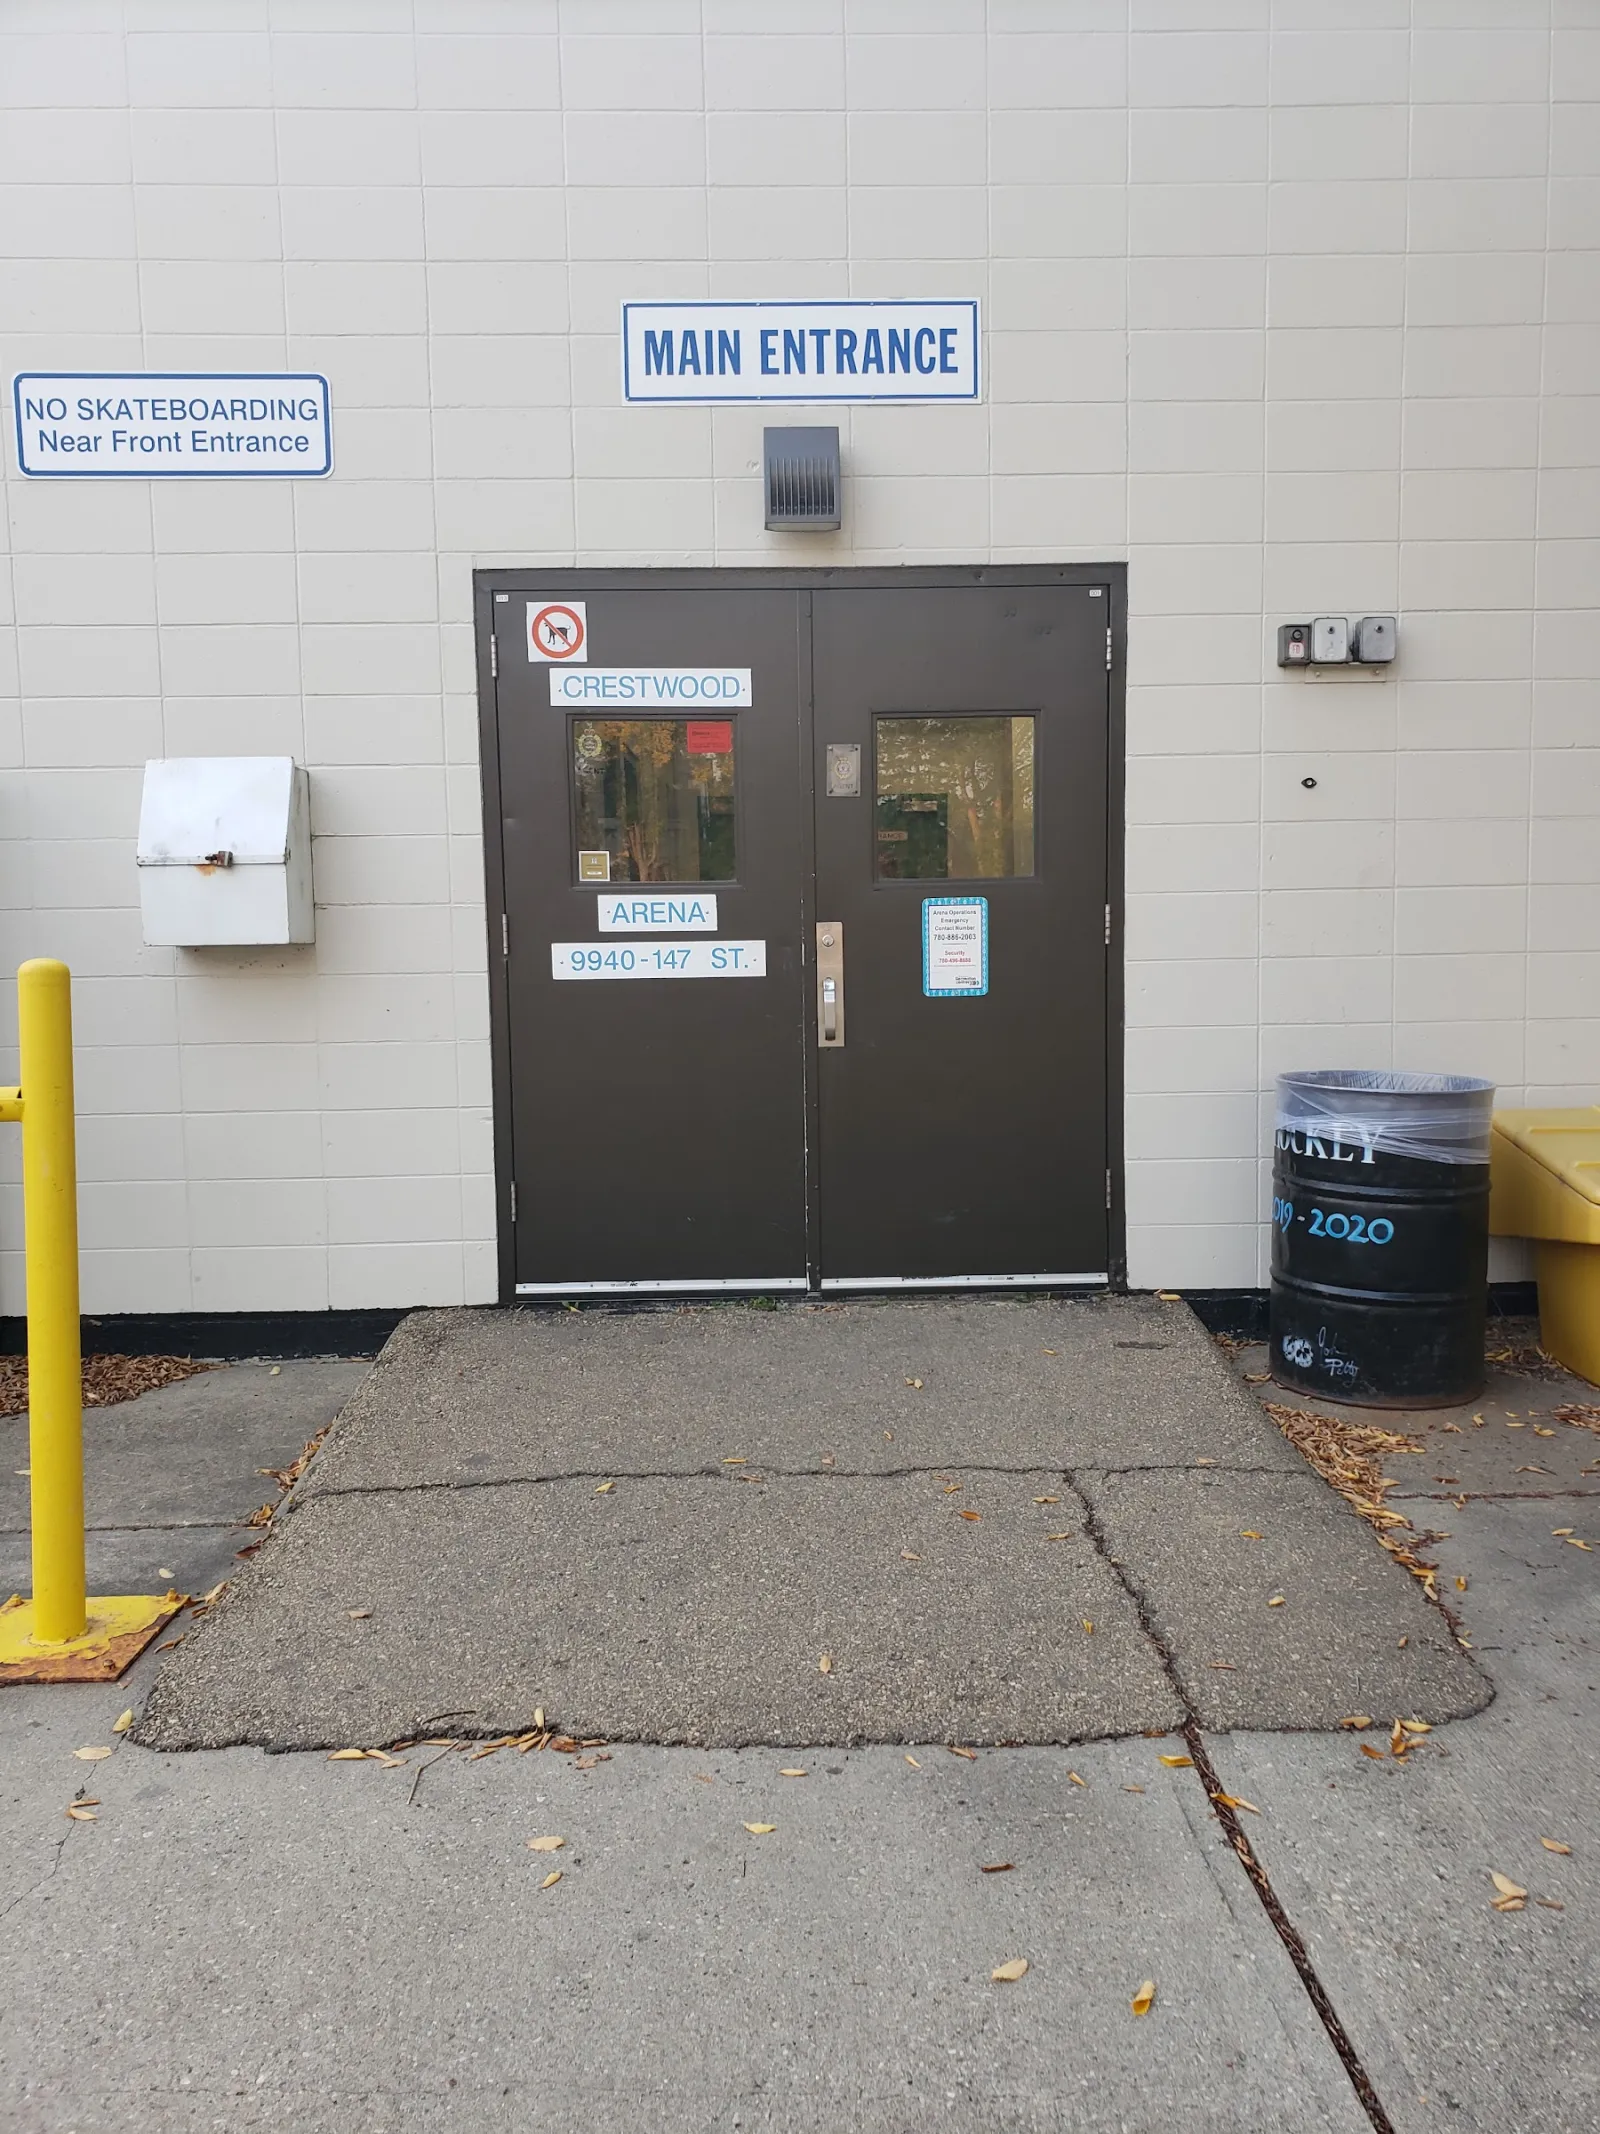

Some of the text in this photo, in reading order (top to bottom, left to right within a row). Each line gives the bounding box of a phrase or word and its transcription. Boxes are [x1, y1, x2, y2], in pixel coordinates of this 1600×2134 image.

[643, 327, 959, 376] MAIN ENTRANCE
[25, 398, 319, 422] NO SKATEBOARDING
[38, 430, 310, 453] Near Front Entrance
[562, 675, 741, 699] CRESTWOOD
[611, 901, 707, 924] ARENA
[710, 947, 749, 969] ST.
[1272, 1196, 1294, 1234] 019
[1308, 1208, 1395, 1245] 2020
